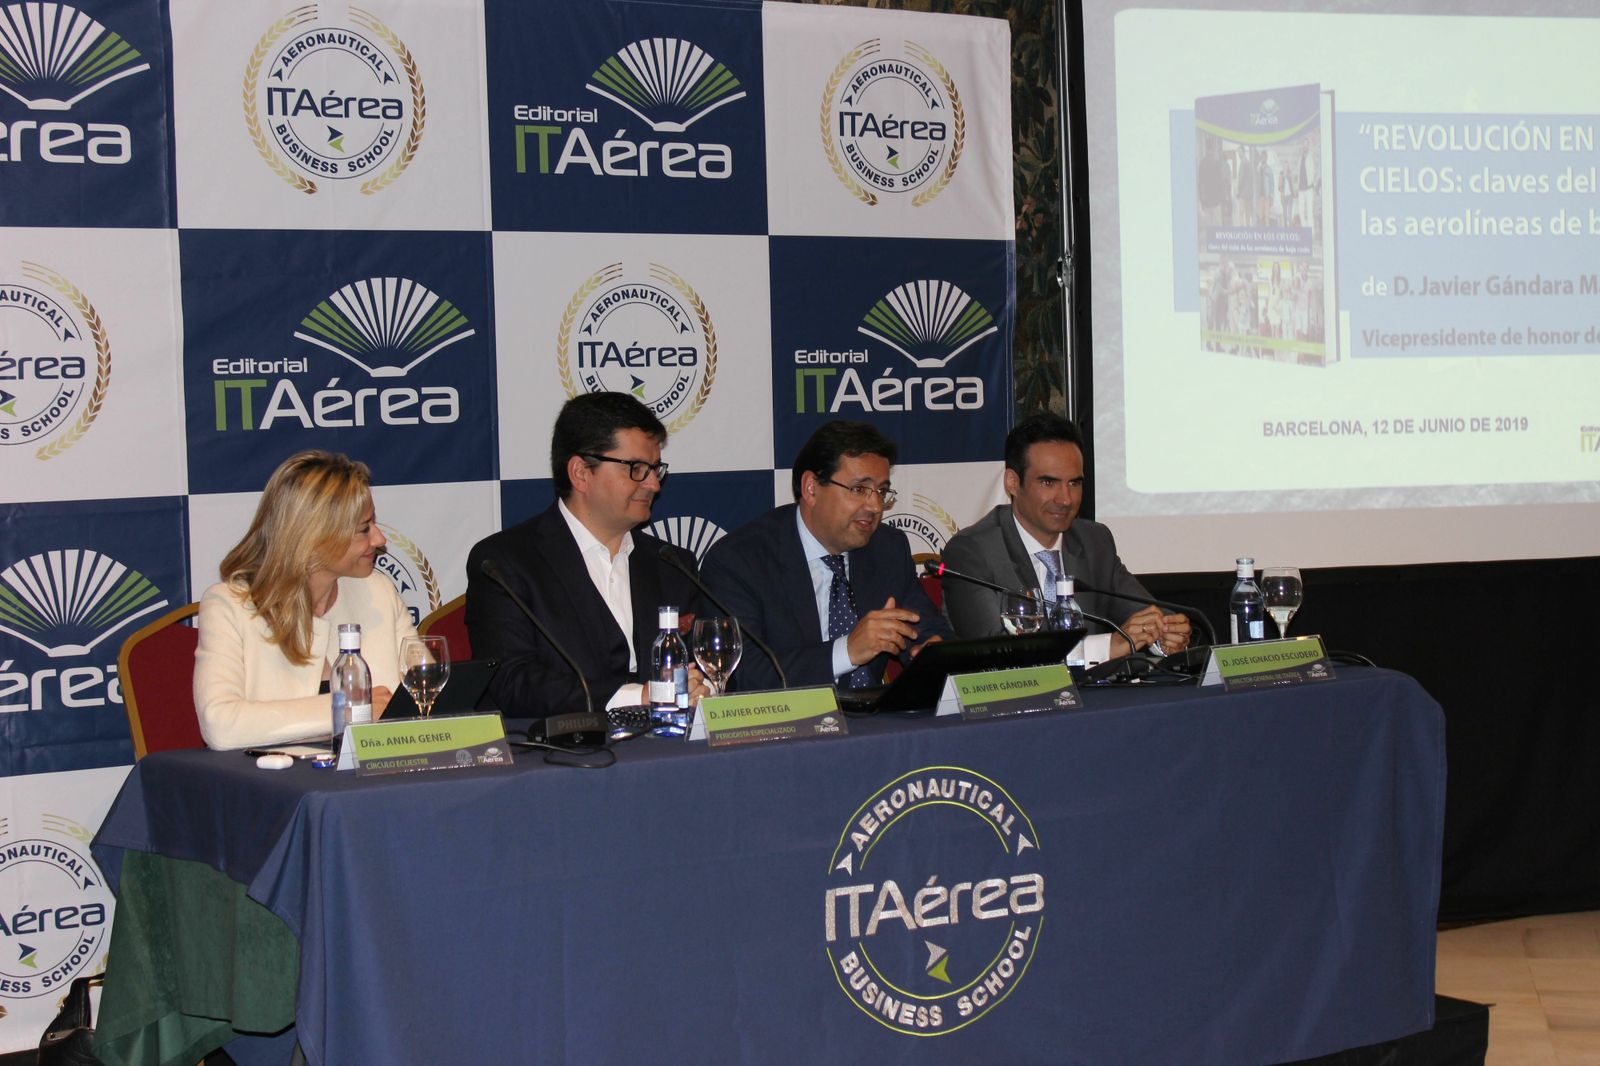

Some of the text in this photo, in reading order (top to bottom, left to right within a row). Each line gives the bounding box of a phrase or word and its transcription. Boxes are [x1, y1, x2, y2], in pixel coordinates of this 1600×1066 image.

[280, 32, 385, 71] AERONAUTICAL
[851, 64, 932, 97] AERONAUTICAL
[267, 86, 403, 120] ITAérea
[514, 104, 598, 123] Editorial
[839, 112, 946, 142] ITAérea
[1560, 125, 1594, 151] EN
[0, 120, 131, 165] rea
[275, 123, 395, 174] BUSINESS SCHOOL
[515, 124, 733, 179] ITAérea
[846, 144, 939, 188] BUSINESS SCHOOL
[1360, 166, 1596, 193] CIELOS: claves del
[1361, 208, 1397, 236] las
[1404, 208, 1543, 236] aerolíneas
[1551, 208, 1582, 236] de
[1362, 274, 1600, 297] de D. Javier Gándara M
[590, 289, 681, 322] AERONAUTICAL
[1362, 328, 1497, 351] Vicepresidente
[1501, 327, 1522, 345] de
[1527, 326, 1580, 345] honor
[213, 357, 308, 375] Editorial
[578, 342, 698, 369] ITAérea
[795, 349, 868, 364] Editorial
[213, 377, 459, 432] ITAérea
[795, 367, 984, 413] ITAérea
[21, 389, 74, 437] SCHOOL
[1263, 417, 1529, 438] BARCELONA, 12 DE JUNIO DE 2019
[889, 518, 939, 548] NAUTICAL
[1232, 657, 1249, 666] JOSÉ
[1250, 654, 1281, 664] IGNACIO
[1282, 650, 1319, 661] ESCUDERO
[972, 683, 998, 694] JAVIER
[1000, 679, 1040, 690] GÁNDARA
[557, 718, 600, 730] PHILIPS
[710, 704, 790, 720] D. JAVIER ORTEGA
[361, 732, 452, 749] Dña. ANNA GENER
[751, 726, 796, 737] ESPECIALIZADO
[851, 778, 1015, 852] AERONAUTICAL
[825, 873, 1045, 942] ITAérea
[42, 936, 95, 988] SCHOOL
[840, 925, 1032, 1028] BUSINESS SCHOOL
